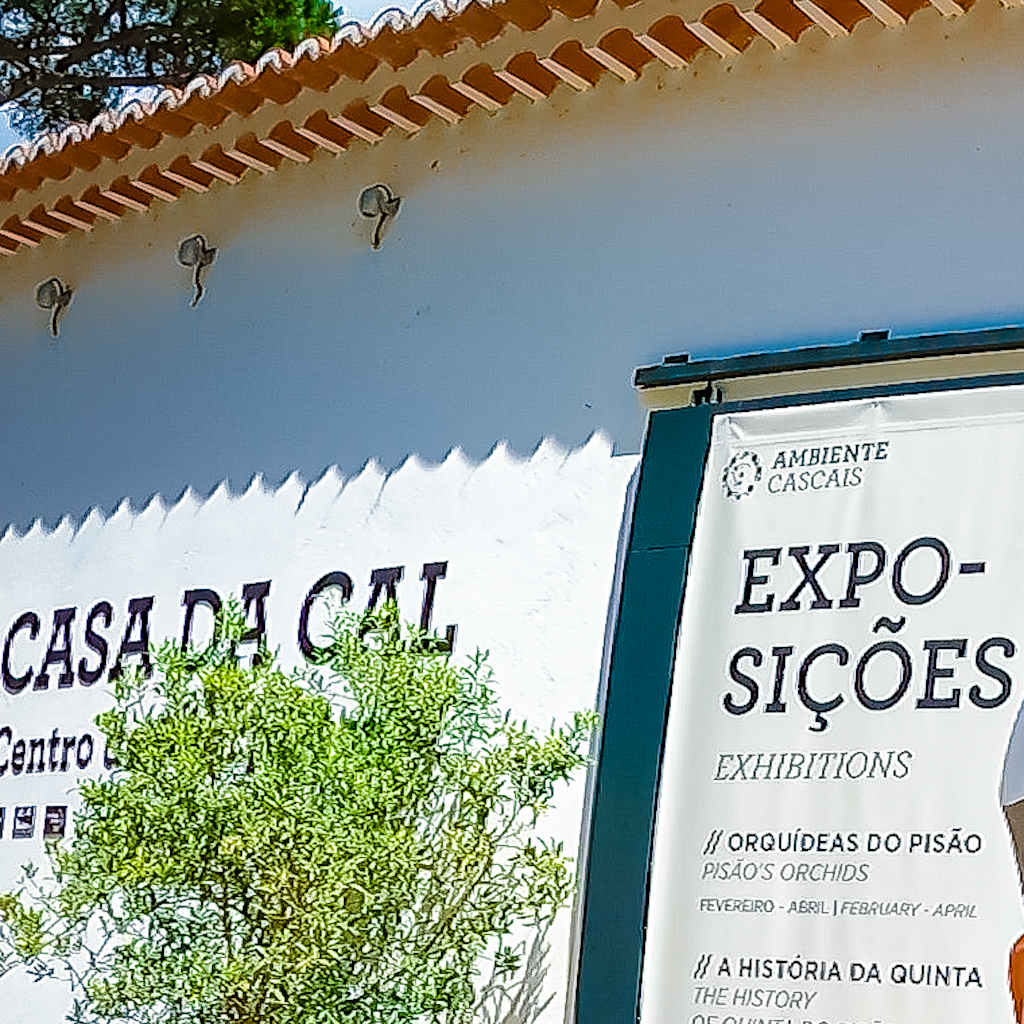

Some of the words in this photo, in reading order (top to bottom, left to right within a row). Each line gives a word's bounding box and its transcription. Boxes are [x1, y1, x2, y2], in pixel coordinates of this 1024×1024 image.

[771, 441, 890, 470] AMBIENTE
[767, 467, 863, 494] CASCAIS
[734, 537, 986, 614] EXPO-
[2, 595, 155, 695] CASA
[181, 580, 272, 672] DA
[298, 560, 458, 668] CAL
[723, 616, 1017, 732] SIÇÕES
[714, 750, 914, 782] EXHIBITIONS
[728, 828, 859, 853] ORQUÍDEAS
[867, 833, 901, 853] DO
[909, 828, 983, 854] PISÃO
[701, 859, 775, 881] PISÃO'S
[780, 862, 870, 882] ORCHIDS
[700, 899, 775, 914] FEVEREIRO
[787, 900, 830, 915] ABRIL
[840, 901, 922, 917] FEBRUARY
[932, 903, 978, 918] APRIL
[718, 957, 731, 978] A
[739, 955, 842, 982] HISTÓRIA
[850, 963, 882, 984] DA
[891, 964, 983, 988] QUINTA
[694, 987, 728, 1006] THE
[732, 988, 818, 1010] HISTORY
